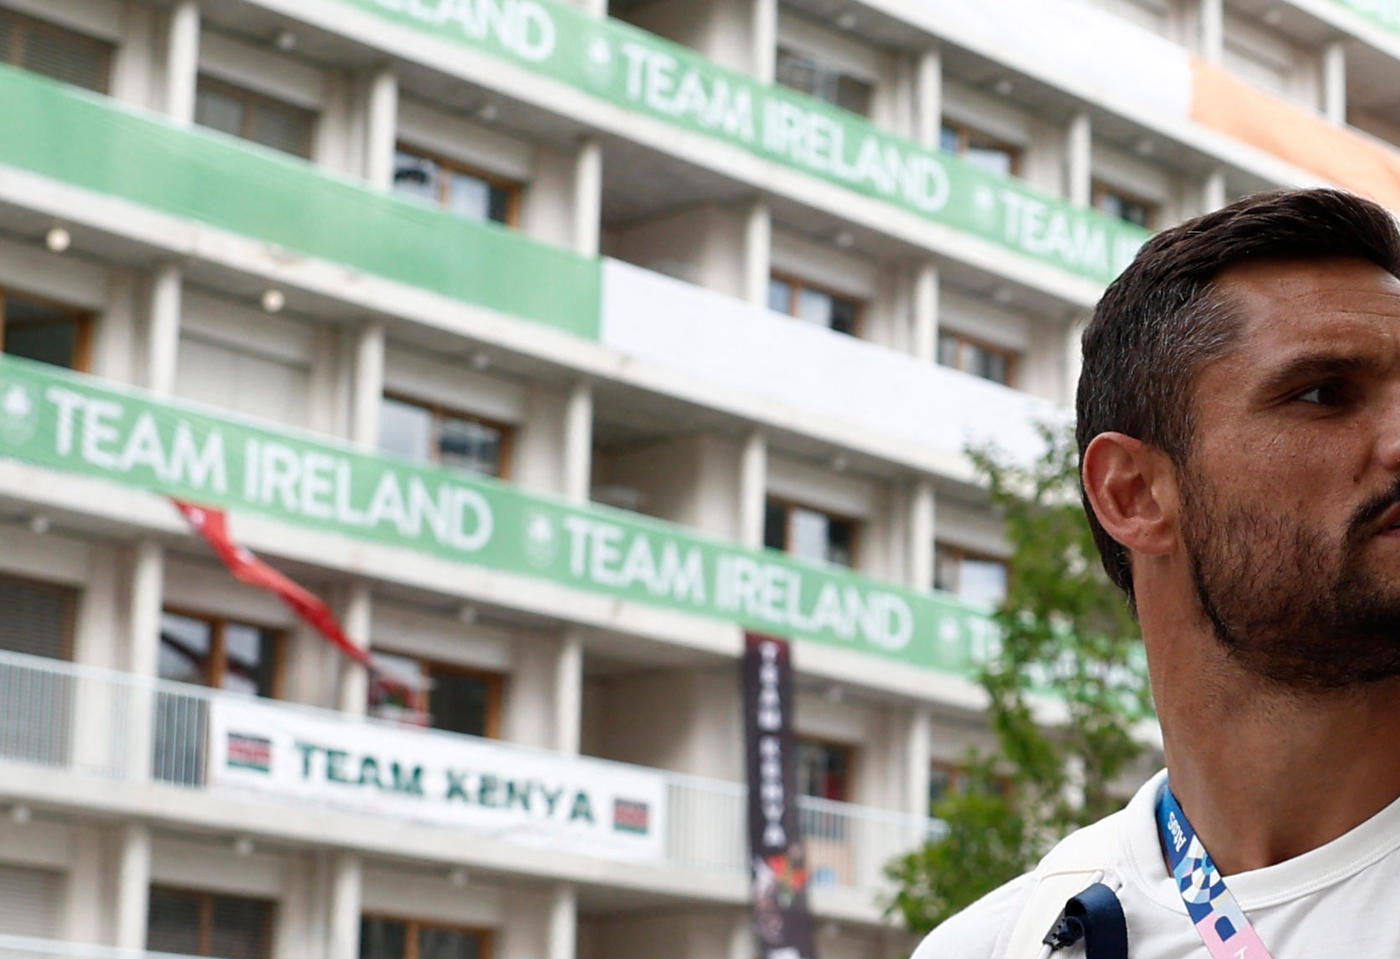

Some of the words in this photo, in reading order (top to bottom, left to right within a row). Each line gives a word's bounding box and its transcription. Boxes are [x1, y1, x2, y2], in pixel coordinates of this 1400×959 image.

[621, 44, 754, 142] TEAM
[762, 97, 949, 211] IRELAND
[1002, 193, 1109, 271] TEAM
[47, 387, 226, 494] TEAM
[243, 438, 493, 551] IRELAND
[563, 516, 706, 602] TEAM
[716, 554, 913, 650] IRELAND
[296, 741, 425, 797] TEAM
[444, 766, 596, 825] KENYA
